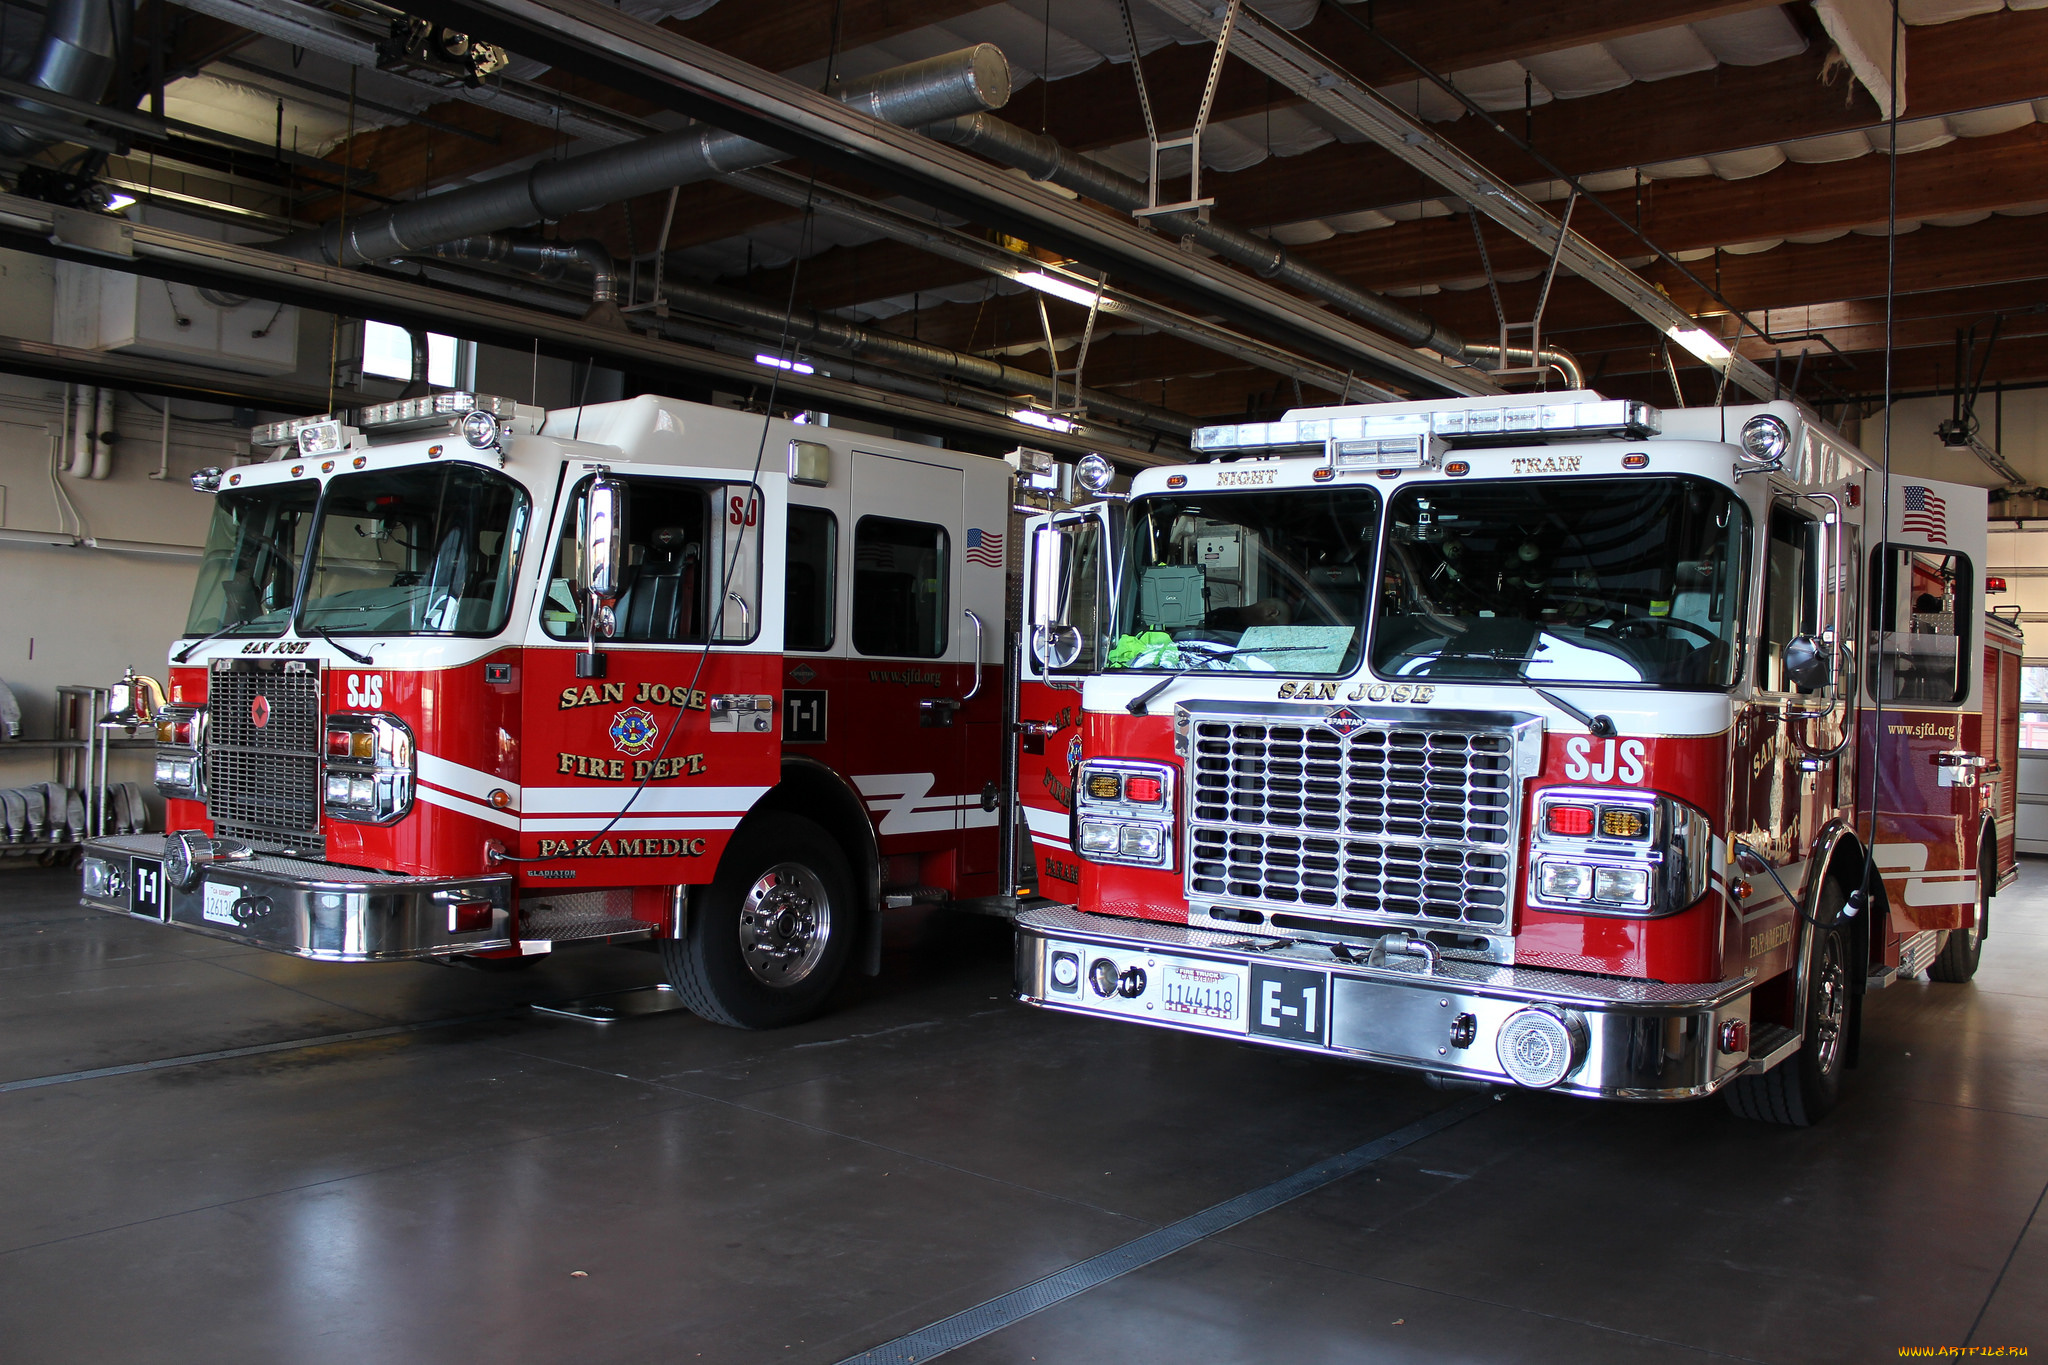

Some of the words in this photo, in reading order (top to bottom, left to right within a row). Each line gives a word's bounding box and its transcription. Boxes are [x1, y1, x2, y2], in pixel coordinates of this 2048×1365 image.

[1216, 469, 1278, 486] NIGHT
[1511, 455, 1583, 474] TRAIN
[730, 495, 757, 527] SJ
[241, 641, 274, 654] SAN
[272, 641, 311, 654] JOSE
[347, 674, 383, 708] SJS
[869, 668, 942, 687] www.sjfd.org
[558, 682, 625, 711] SAN
[634, 682, 707, 711] JOSE
[1278, 681, 1342, 700] SAN
[1347, 683, 1436, 703] JOSE
[790, 700, 818, 732] T-1
[1327, 717, 1364, 726] SPARTAN
[1887, 723, 1956, 740] www.sjfd.org
[558, 752, 625, 780] FIRE
[632, 752, 707, 780] DEPT.
[1565, 737, 1645, 784] SJS
[1753, 735, 1774, 779] SAN
[538, 837, 706, 858] PARAMEDIC
[138, 868, 157, 904] T-1
[1749, 922, 1791, 958] PARAMEDIC
[1193, 975, 1219, 984] EXEMPT
[1165, 1002, 1231, 1019] HI-TECH
[1168, 983, 1232, 1011] 1144118
[1261, 980, 1317, 1033] E-1
